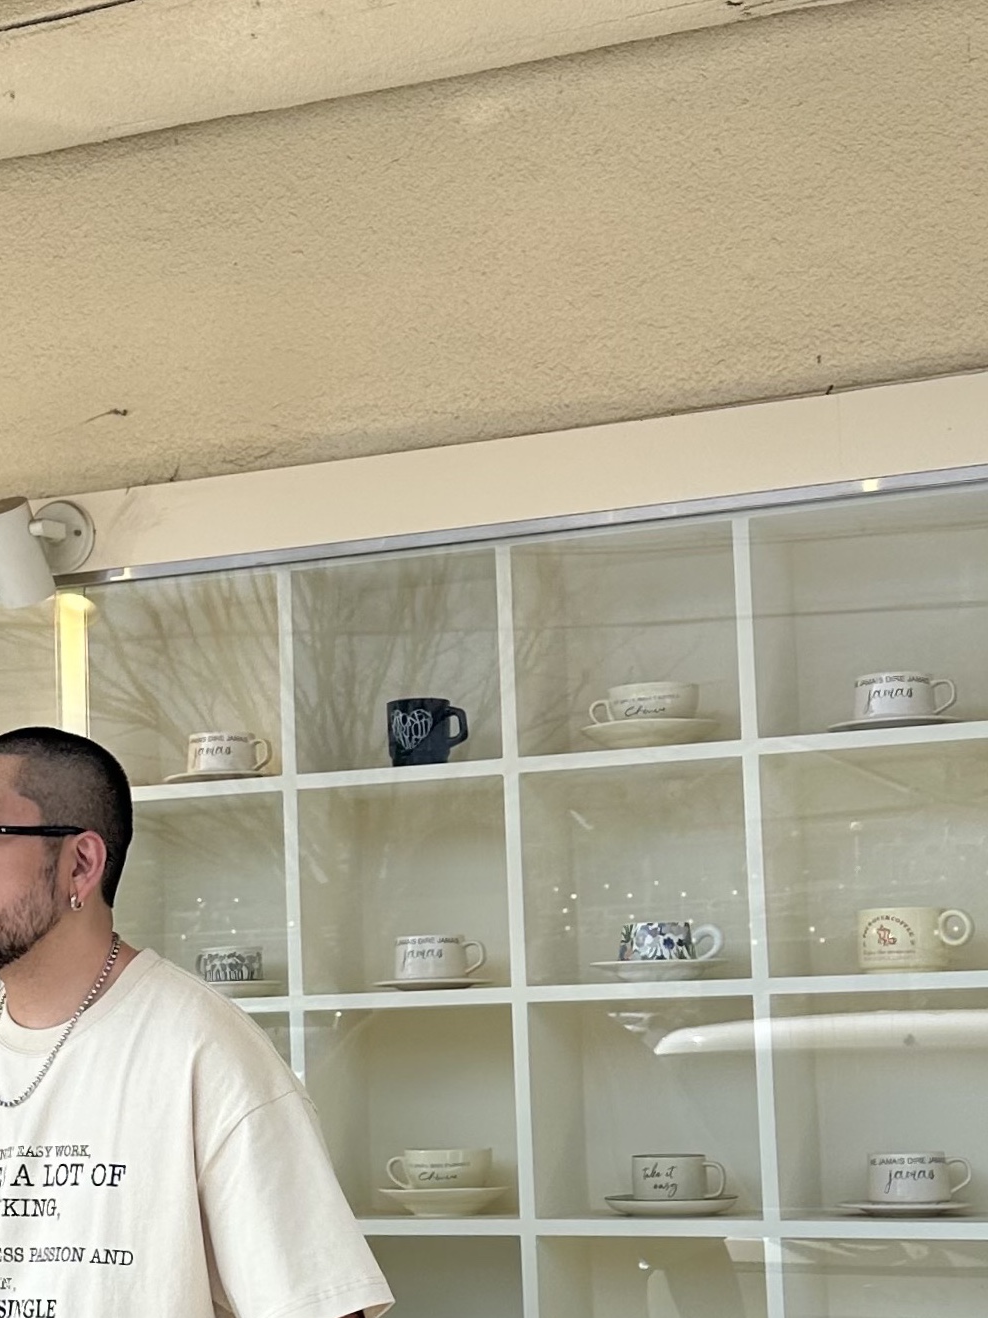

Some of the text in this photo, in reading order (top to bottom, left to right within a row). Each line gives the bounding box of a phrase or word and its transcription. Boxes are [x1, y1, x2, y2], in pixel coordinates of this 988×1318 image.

[16, 1145, 52, 1157] EASY
[9, 1163, 35, 1187] A
[42, 1163, 85, 1187] LOT
[91, 1163, 127, 1187] OF
[89, 1249, 134, 1266] AND
